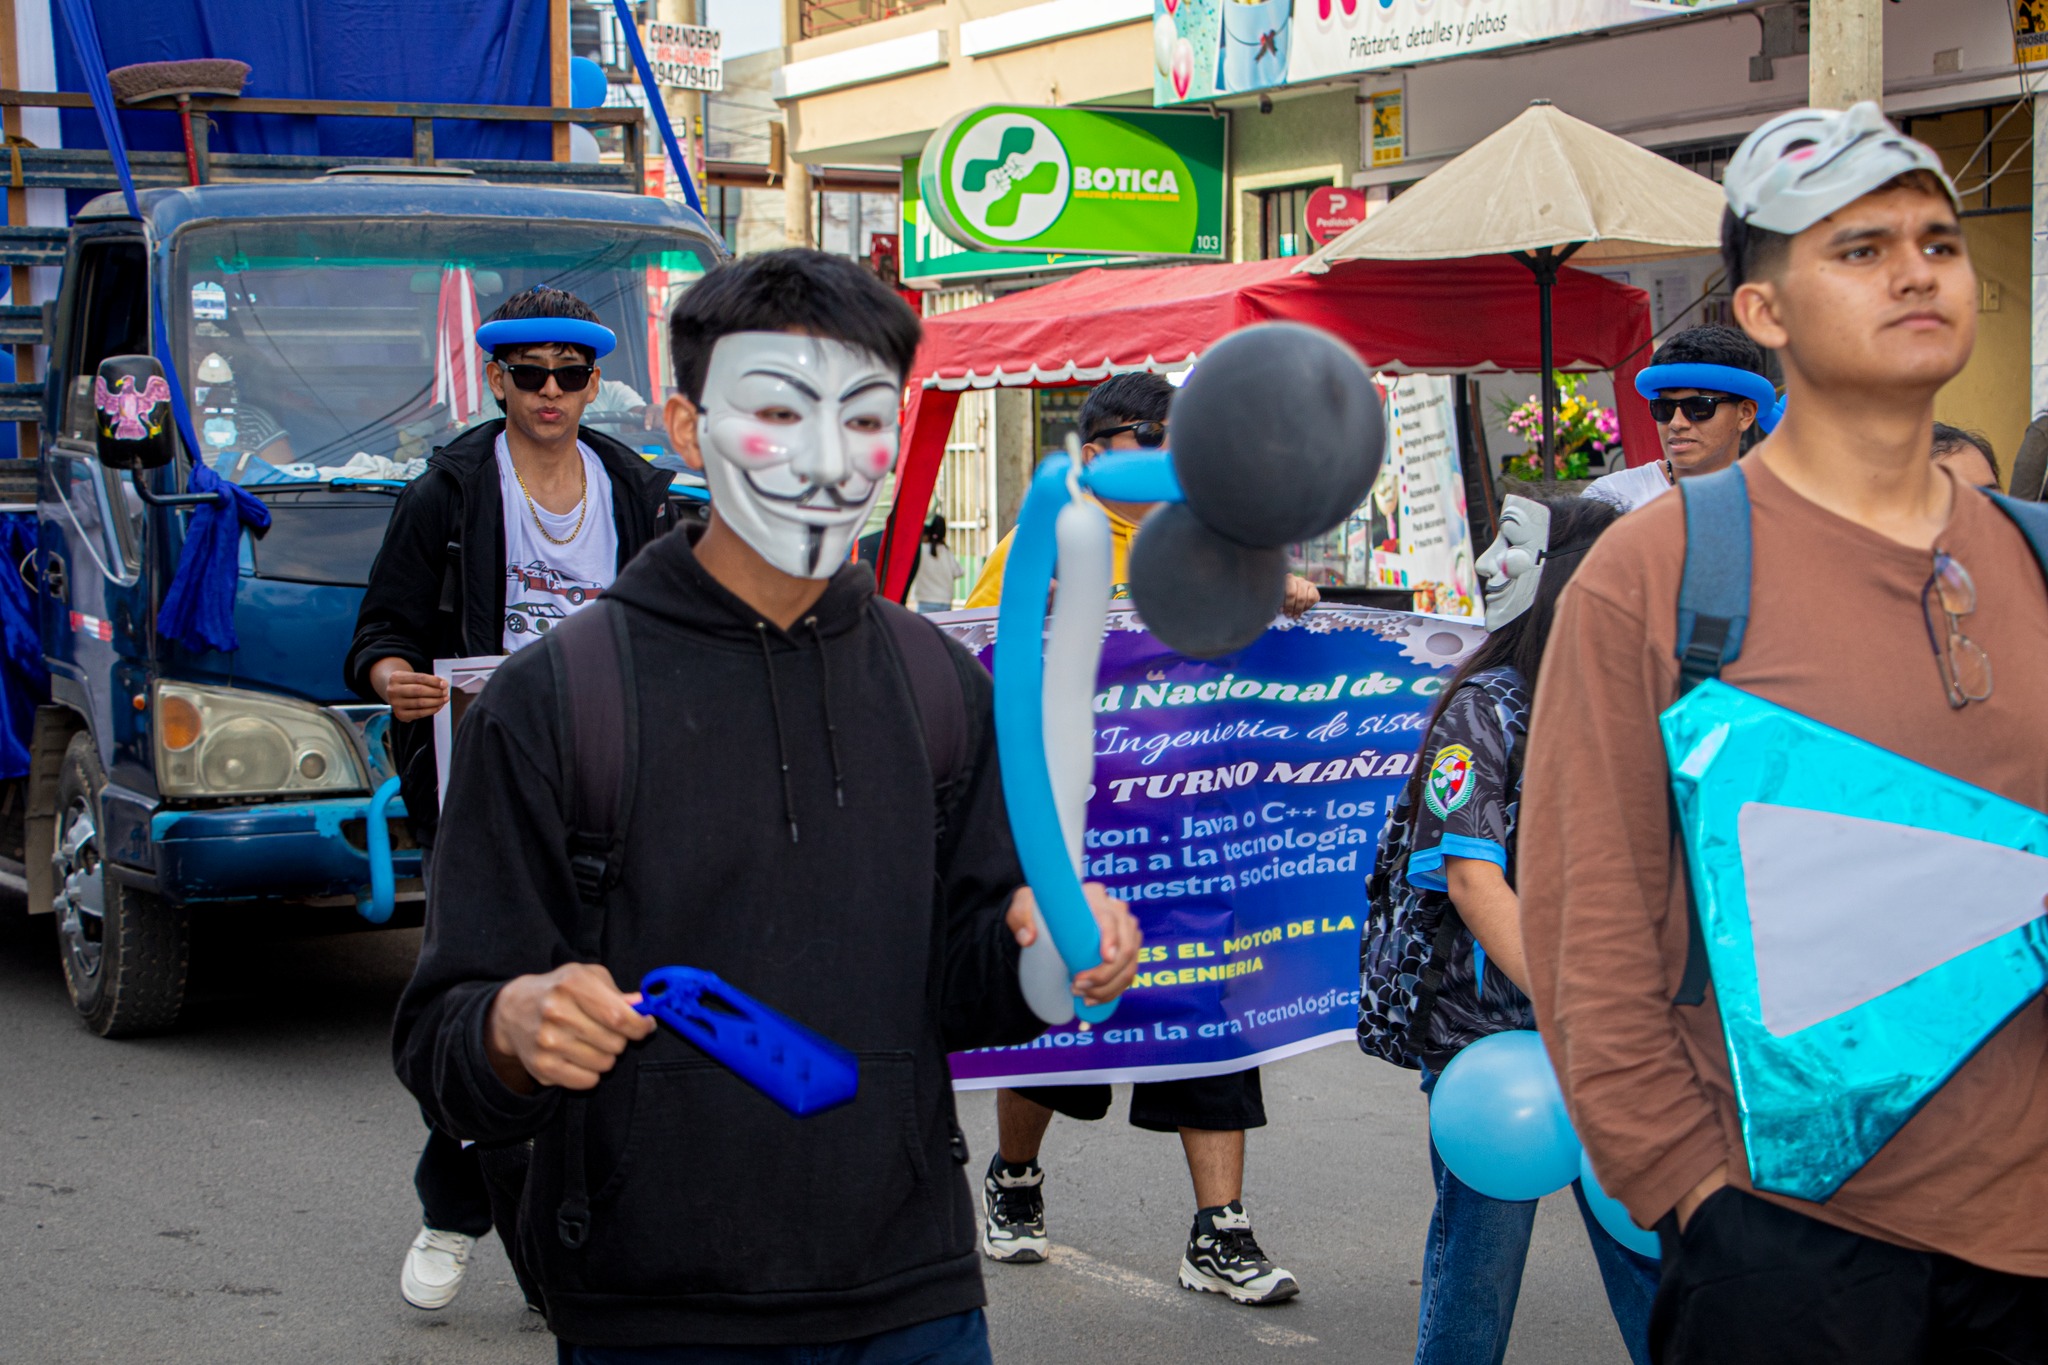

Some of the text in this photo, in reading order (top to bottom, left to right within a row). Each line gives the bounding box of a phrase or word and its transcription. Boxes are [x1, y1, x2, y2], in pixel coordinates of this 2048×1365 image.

[650, 24, 721, 50] CURANDERO
[1349, 13, 1508, 59] Piñatería, detalles y globos
[1074, 166, 1179, 193] BOTICA
[1197, 235, 1219, 250] 103
[1130, 673, 1348, 709] Nacional
[1350, 672, 1403, 697] de
[1306, 711, 1350, 743] de
[1355, 712, 1432, 737] siste
[1108, 761, 1259, 803] TURNO
[1263, 749, 1419, 784] MAÑA
[1084, 826, 1149, 848] ton
[1180, 815, 1238, 839] Java
[1243, 810, 1256, 828] o
[1261, 801, 1317, 823] C++
[1326, 799, 1376, 820] los
[1082, 852, 1139, 877] ida
[1148, 853, 1172, 871] a
[1182, 845, 1219, 868] la
[1105, 850, 1358, 902] nuestra sociedad
[1178, 942, 1215, 959] EL
[1223, 926, 1282, 955] MOTOR
[1287, 920, 1315, 939] DE
[1321, 915, 1356, 933] LA
[1126, 956, 1264, 989] NGENIERIA
[1102, 1027, 1144, 1044] en
[1153, 1021, 1189, 1041] la
[1198, 1018, 1243, 1037] era
